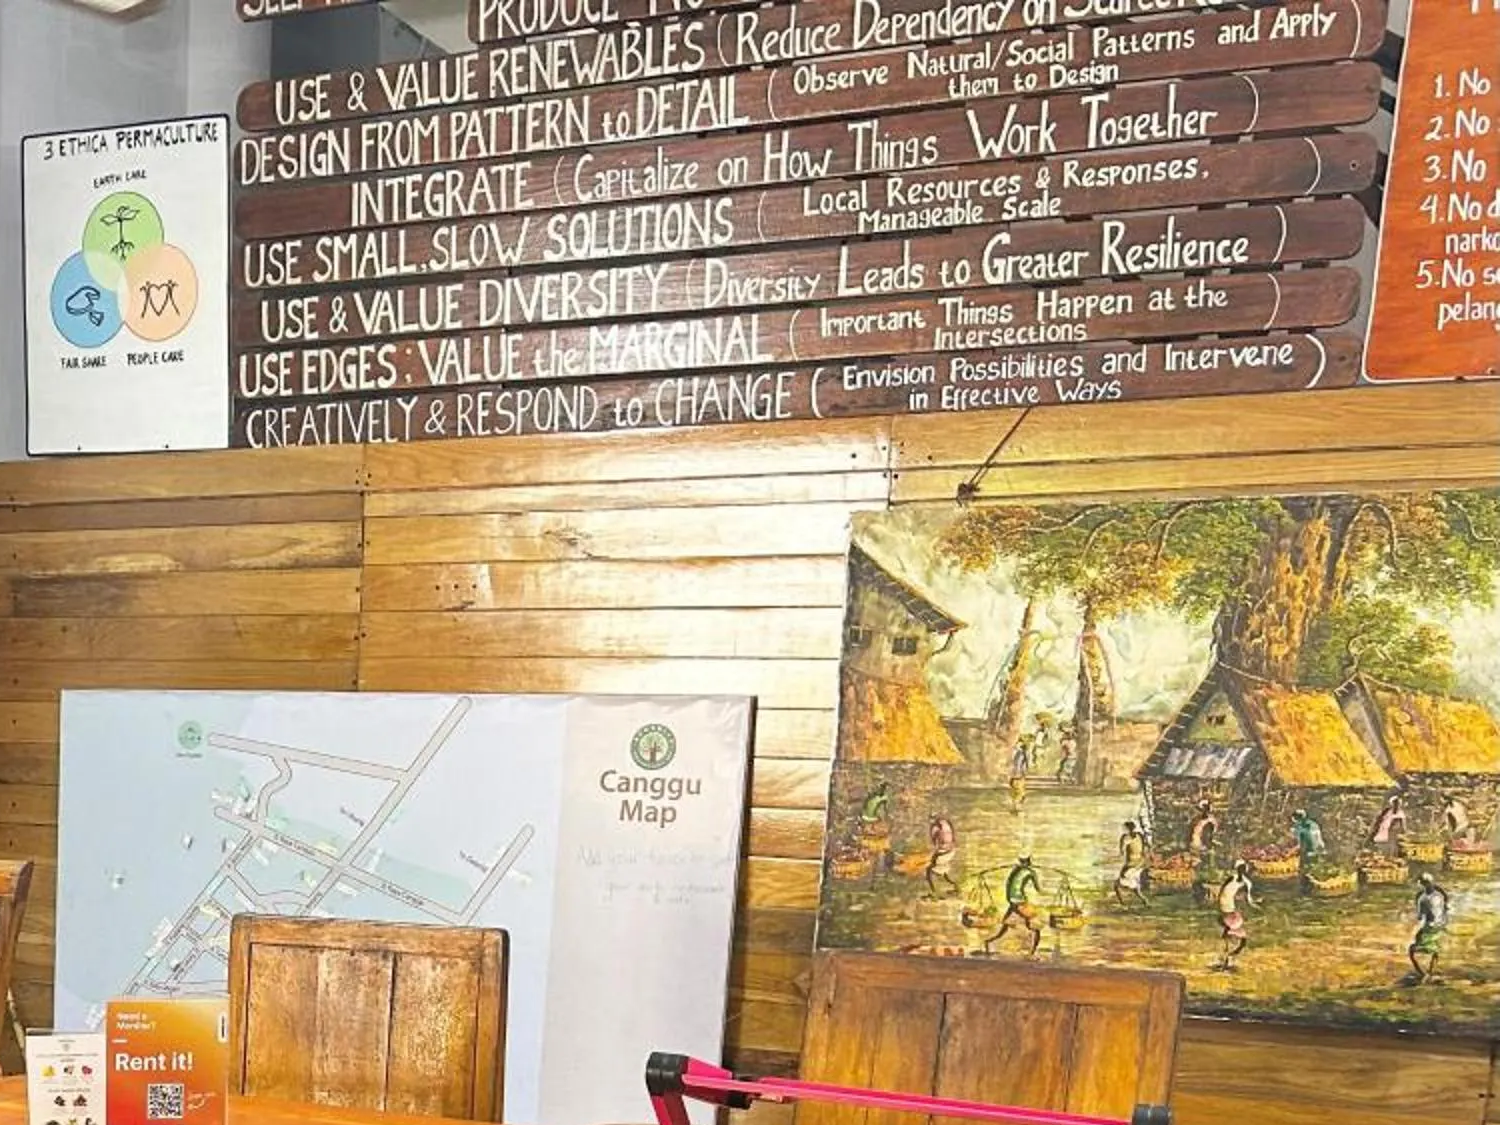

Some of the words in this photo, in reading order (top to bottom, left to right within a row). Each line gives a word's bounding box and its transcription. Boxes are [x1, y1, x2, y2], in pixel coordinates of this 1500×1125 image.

[275, 74, 331, 125] USE
[346, 71, 368, 112] &
[376, 57, 478, 112] VALUE
[488, 20, 706, 99] RENEWABLES
[853, 0, 1013, 50] Dependency
[949, 76, 999, 98] them
[1013, 71, 1037, 92] to
[1050, 63, 1119, 89] Design
[240, 121, 351, 185] DESIGN
[361, 112, 440, 173] FROM
[450, 96, 590, 162] PATTERN
[602, 110, 630, 142] to
[636, 77, 750, 136] DETAIL
[793, 64, 889, 94] Observe
[1093, 27, 1195, 58] Patterns
[1218, 11, 1258, 44] and
[1270, 3, 1336, 39] Apply
[1459, 67, 1491, 96] No
[43, 141, 54, 161] 3
[116, 122, 219, 150] PERMACULTURE
[1454, 108, 1490, 138] No
[351, 162, 533, 226] INTEGRATE
[718, 156, 747, 184] on
[764, 134, 832, 182] How
[849, 120, 938, 172] Things
[966, 101, 1055, 158] Work
[1082, 85, 1217, 149] Together
[244, 240, 302, 287] USE
[429, 218, 529, 270] SLOW
[544, 199, 733, 261] SOLUTIONS
[803, 181, 867, 215] Local
[887, 175, 1020, 206] Resources
[1036, 167, 1050, 188] &
[858, 201, 983, 234] Manageable
[1001, 192, 1062, 219] Scale
[261, 296, 319, 343] USE
[330, 295, 348, 333] &
[354, 283, 464, 335] VALUE
[479, 262, 667, 328] DIVERSITY
[837, 240, 924, 295] Leads
[940, 257, 971, 284] to
[983, 232, 1089, 283] Greater
[1101, 221, 1249, 275] Resilience
[239, 352, 294, 398] USE
[418, 332, 523, 386] VALUE
[532, 331, 579, 378] the
[589, 314, 775, 372] MARGINAL
[820, 307, 927, 337] Important
[938, 296, 1014, 329] Things
[1036, 285, 1134, 323] Happen
[1148, 288, 1177, 311] at
[1184, 283, 1229, 311] the
[934, 320, 1088, 351] Intersections
[127, 352, 158, 366] PEOPLE
[245, 396, 418, 452] CREATIVELY
[425, 397, 448, 435] &
[457, 384, 598, 438] RESPOND
[613, 396, 645, 427] to
[655, 370, 797, 427] CHANGE
[843, 360, 936, 391] Envision
[949, 345, 1084, 384] Possibilities
[1101, 340, 1147, 376] and
[1165, 340, 1294, 372] Intervene
[909, 387, 928, 413] in
[941, 382, 1040, 411] Effective
[1056, 377, 1123, 404] Ways
[600, 769, 701, 800] Canggu
[619, 800, 677, 829] Map
[115, 1053, 166, 1072] Rent
[172, 1051, 193, 1072] it!
